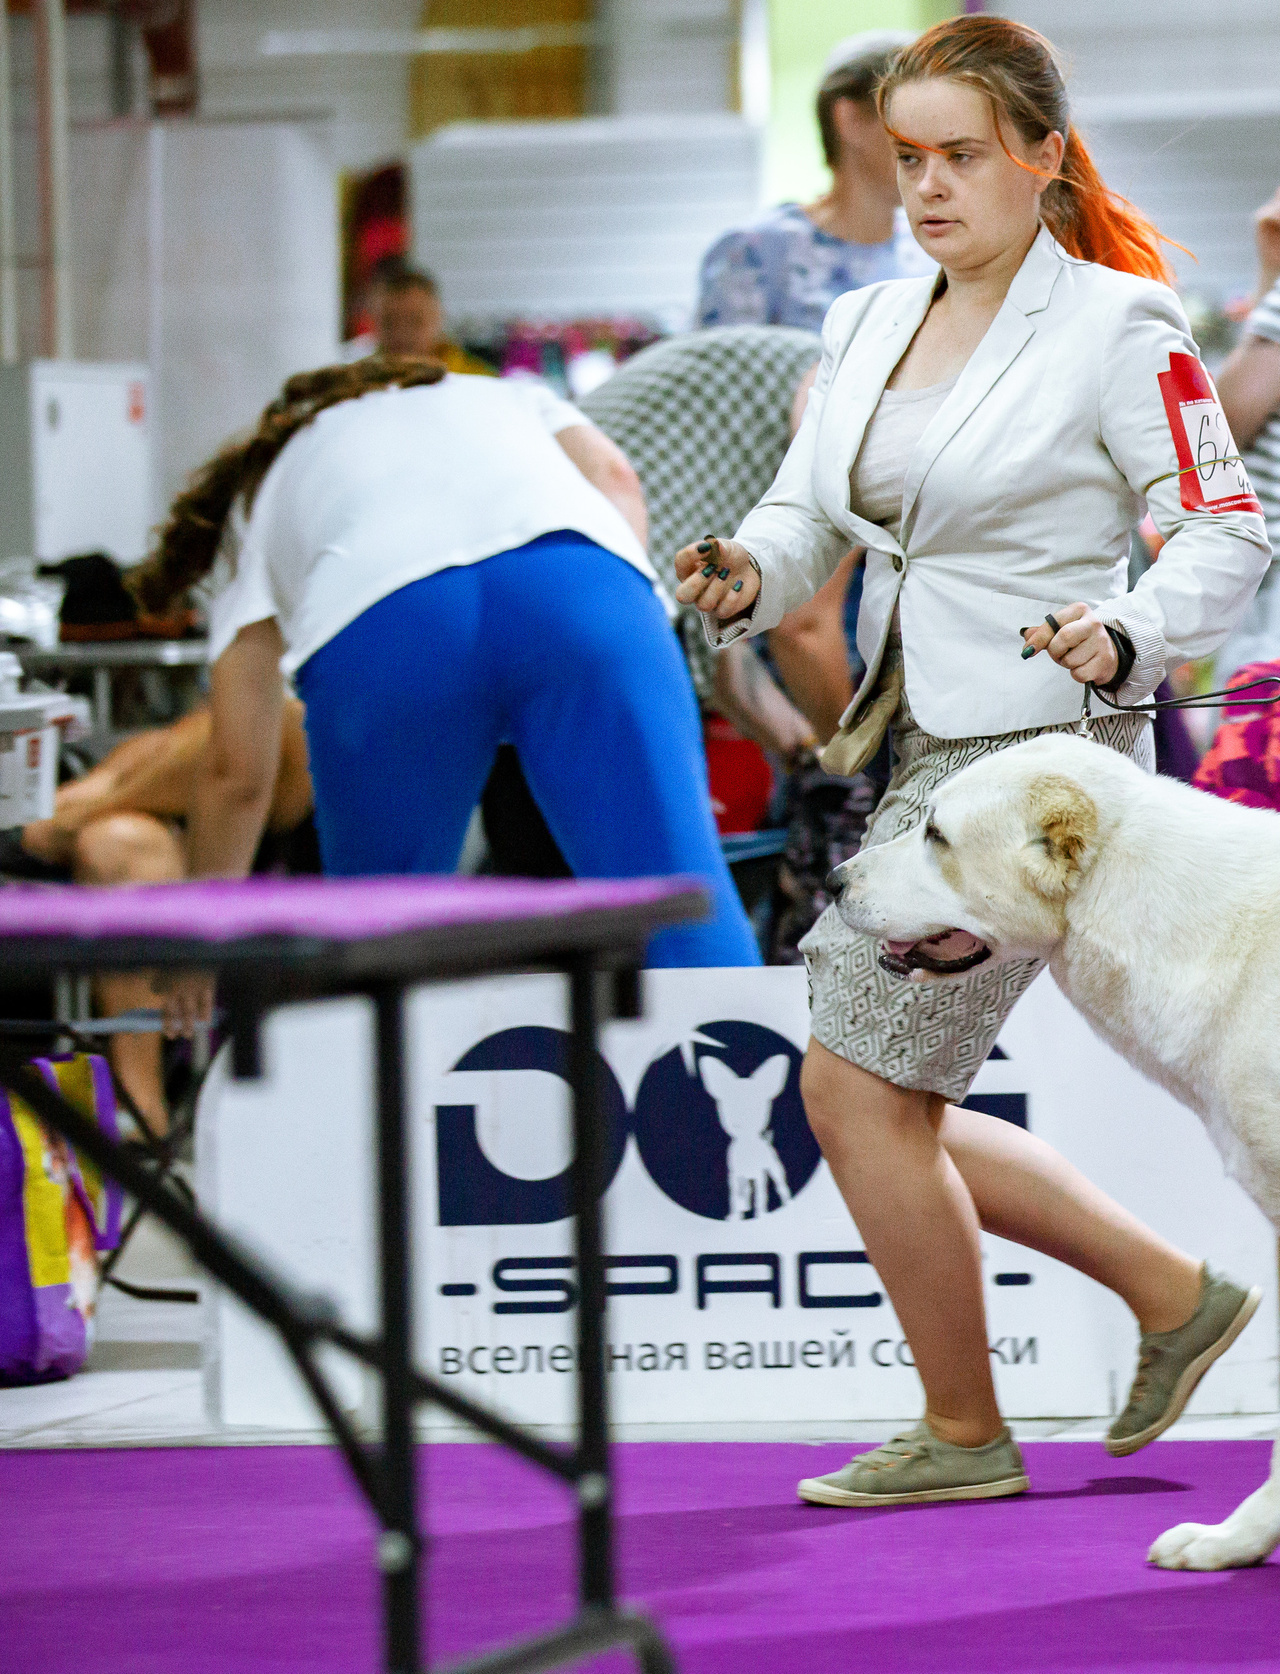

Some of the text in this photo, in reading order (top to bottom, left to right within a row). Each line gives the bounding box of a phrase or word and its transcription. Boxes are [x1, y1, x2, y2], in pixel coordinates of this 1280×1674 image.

[435, 1020, 1028, 1226] DO
[440, 1329, 1039, 1375] вселеная вашей соки
